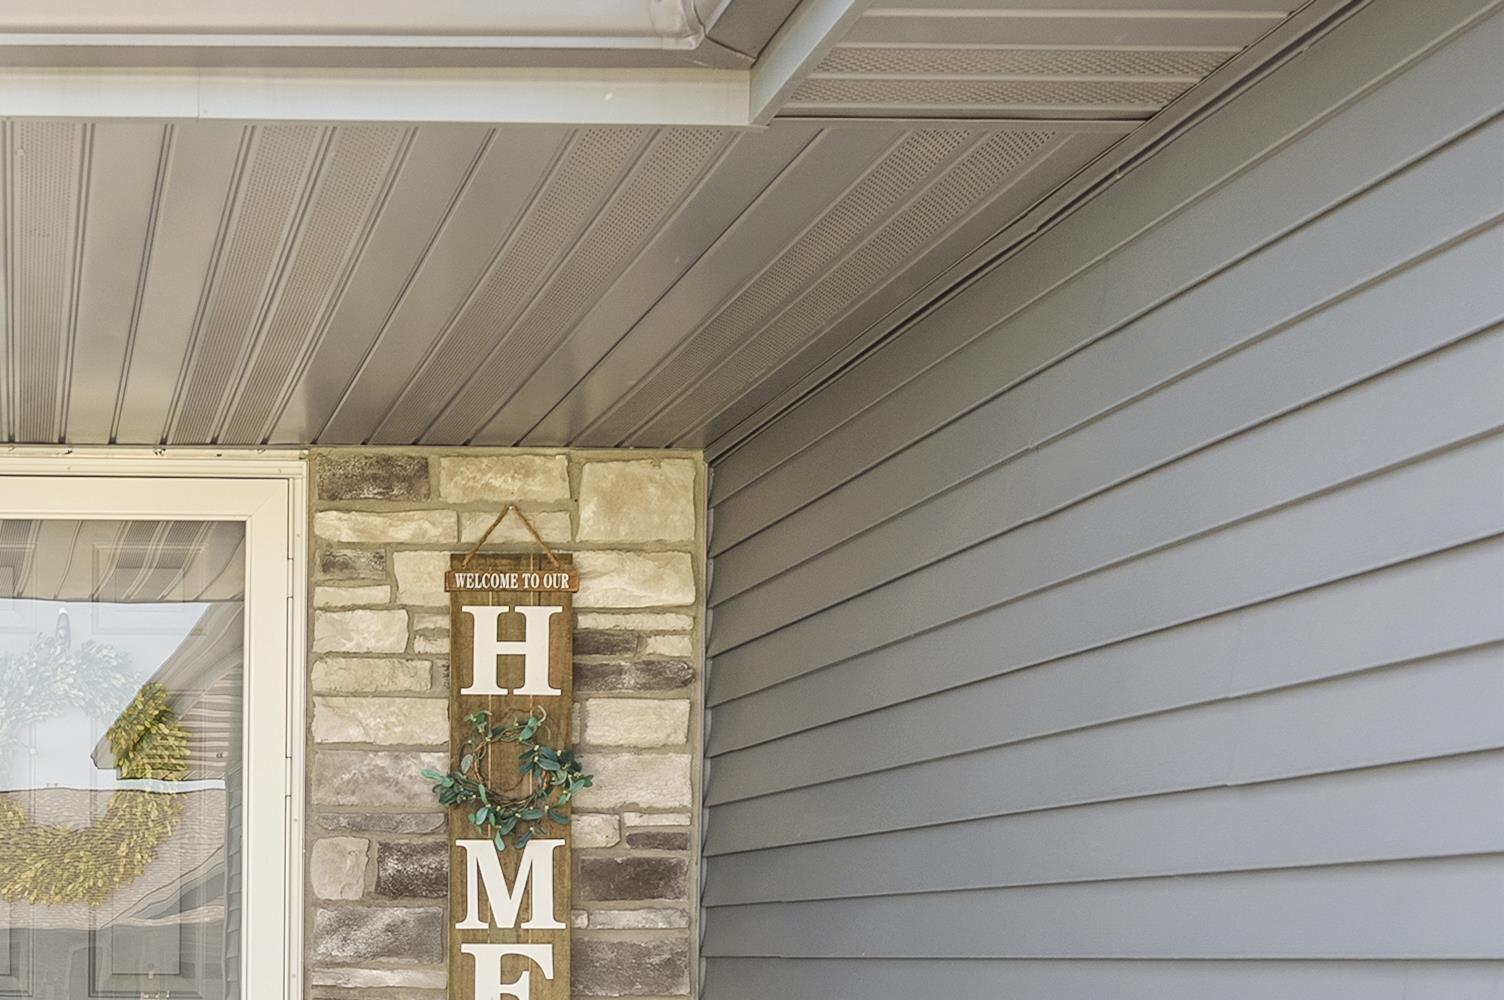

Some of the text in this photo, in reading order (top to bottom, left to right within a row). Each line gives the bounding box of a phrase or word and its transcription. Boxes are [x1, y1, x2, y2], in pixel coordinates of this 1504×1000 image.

[455, 572, 569, 589] WELCOME TO OUR
